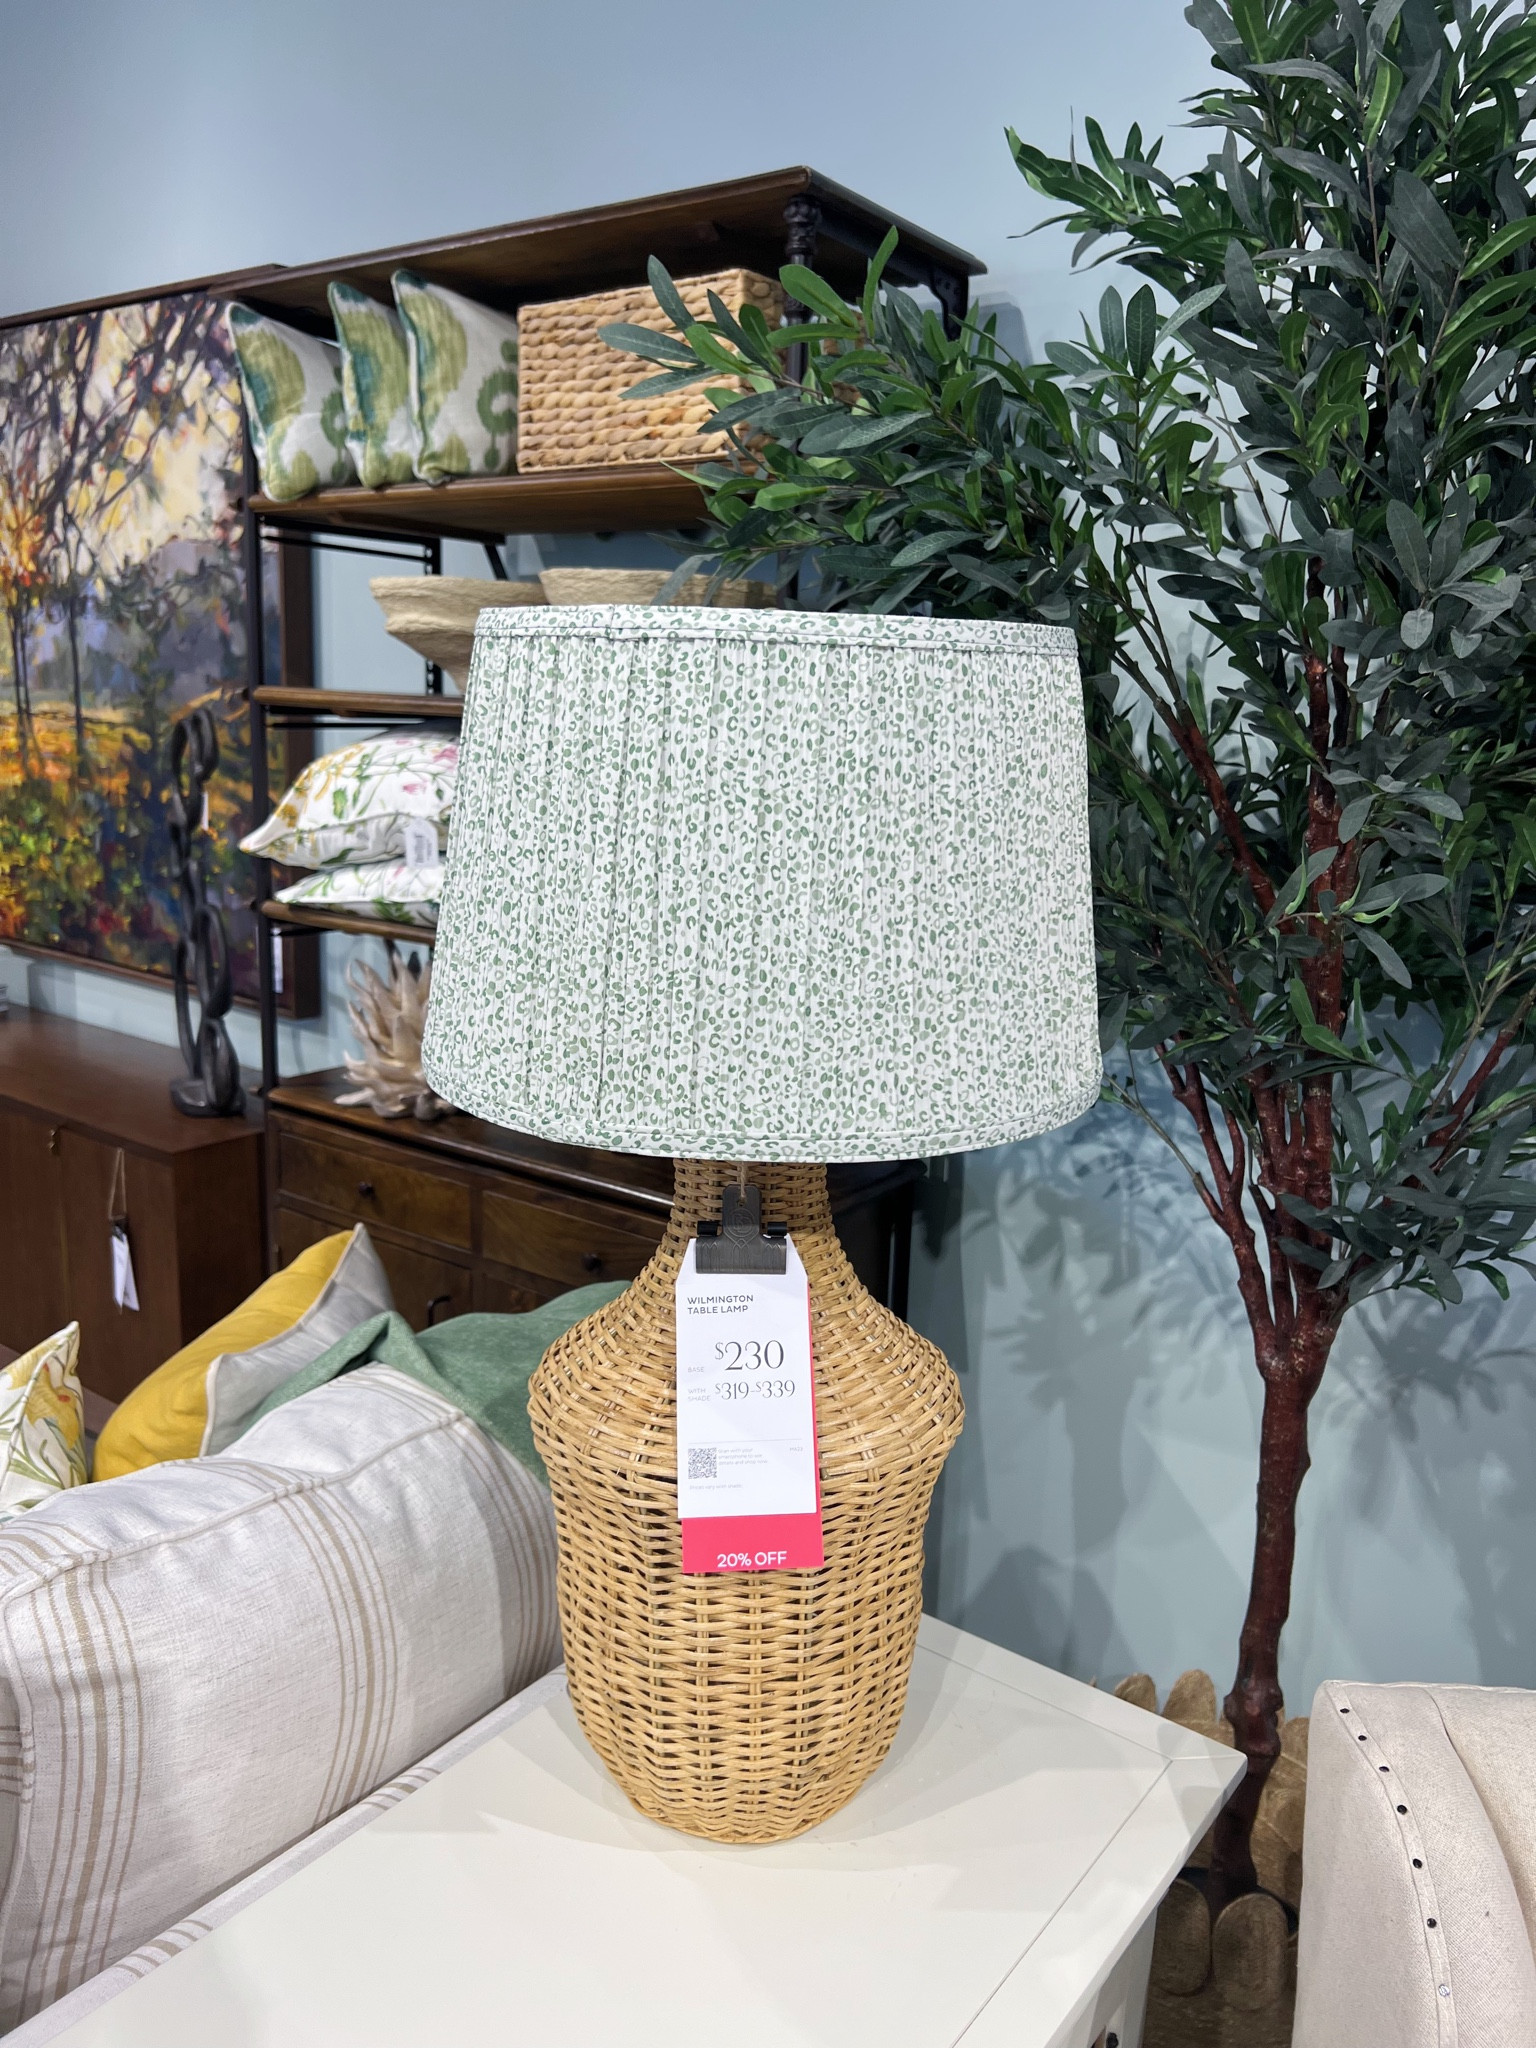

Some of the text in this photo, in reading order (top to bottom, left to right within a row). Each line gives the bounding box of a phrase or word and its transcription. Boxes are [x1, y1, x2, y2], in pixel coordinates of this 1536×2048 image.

[687, 1295, 754, 1305] WILMINGTON
[687, 1305, 749, 1315] TABLE LAMP
[714, 1339, 785, 1371] $230
[716, 1550, 788, 1568] 20% OFF
